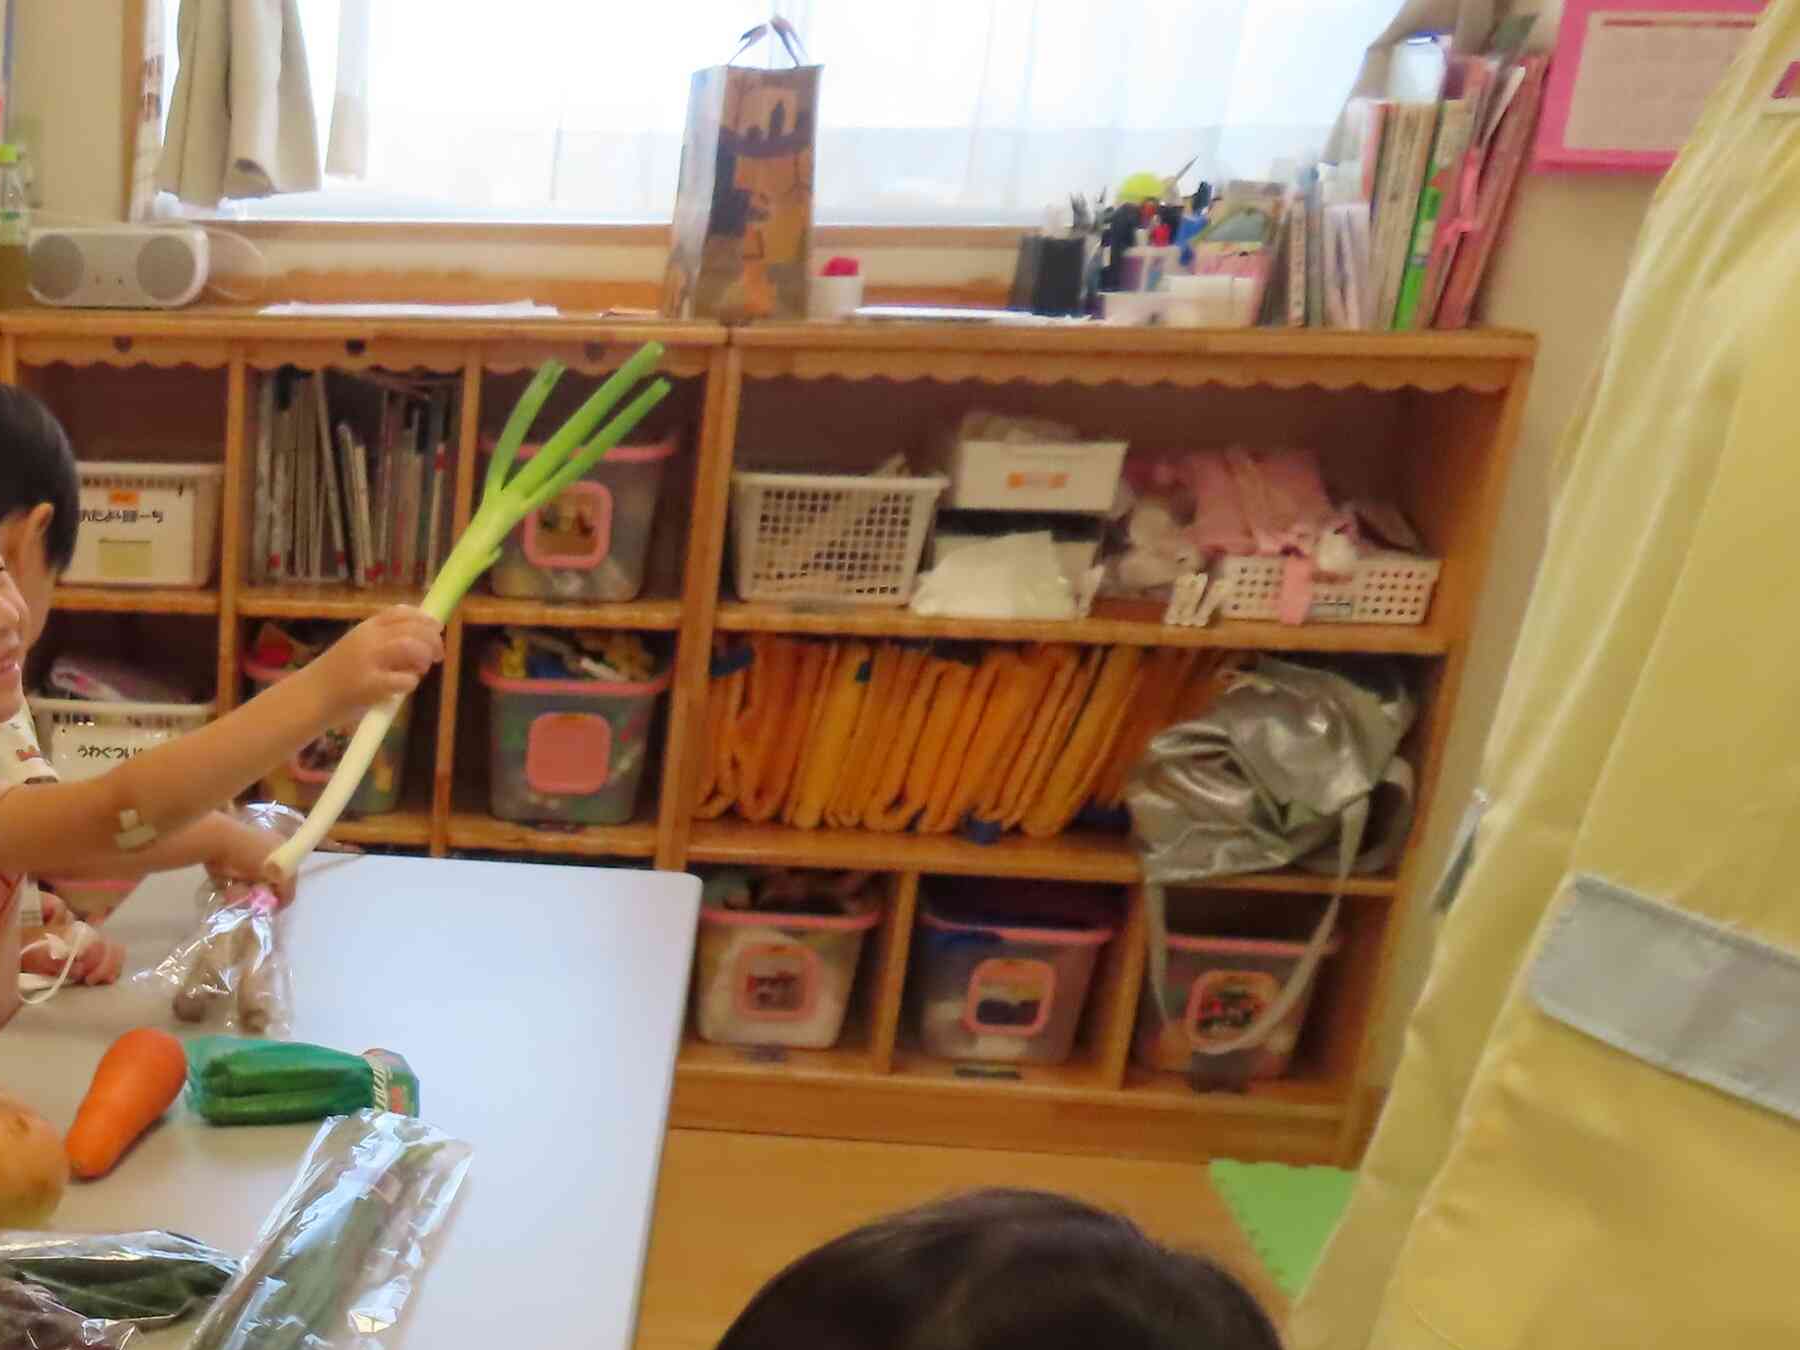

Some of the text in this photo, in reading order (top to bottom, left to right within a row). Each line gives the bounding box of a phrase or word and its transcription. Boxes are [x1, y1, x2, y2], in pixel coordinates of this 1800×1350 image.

[77, 744, 143, 760] うわぐつい
